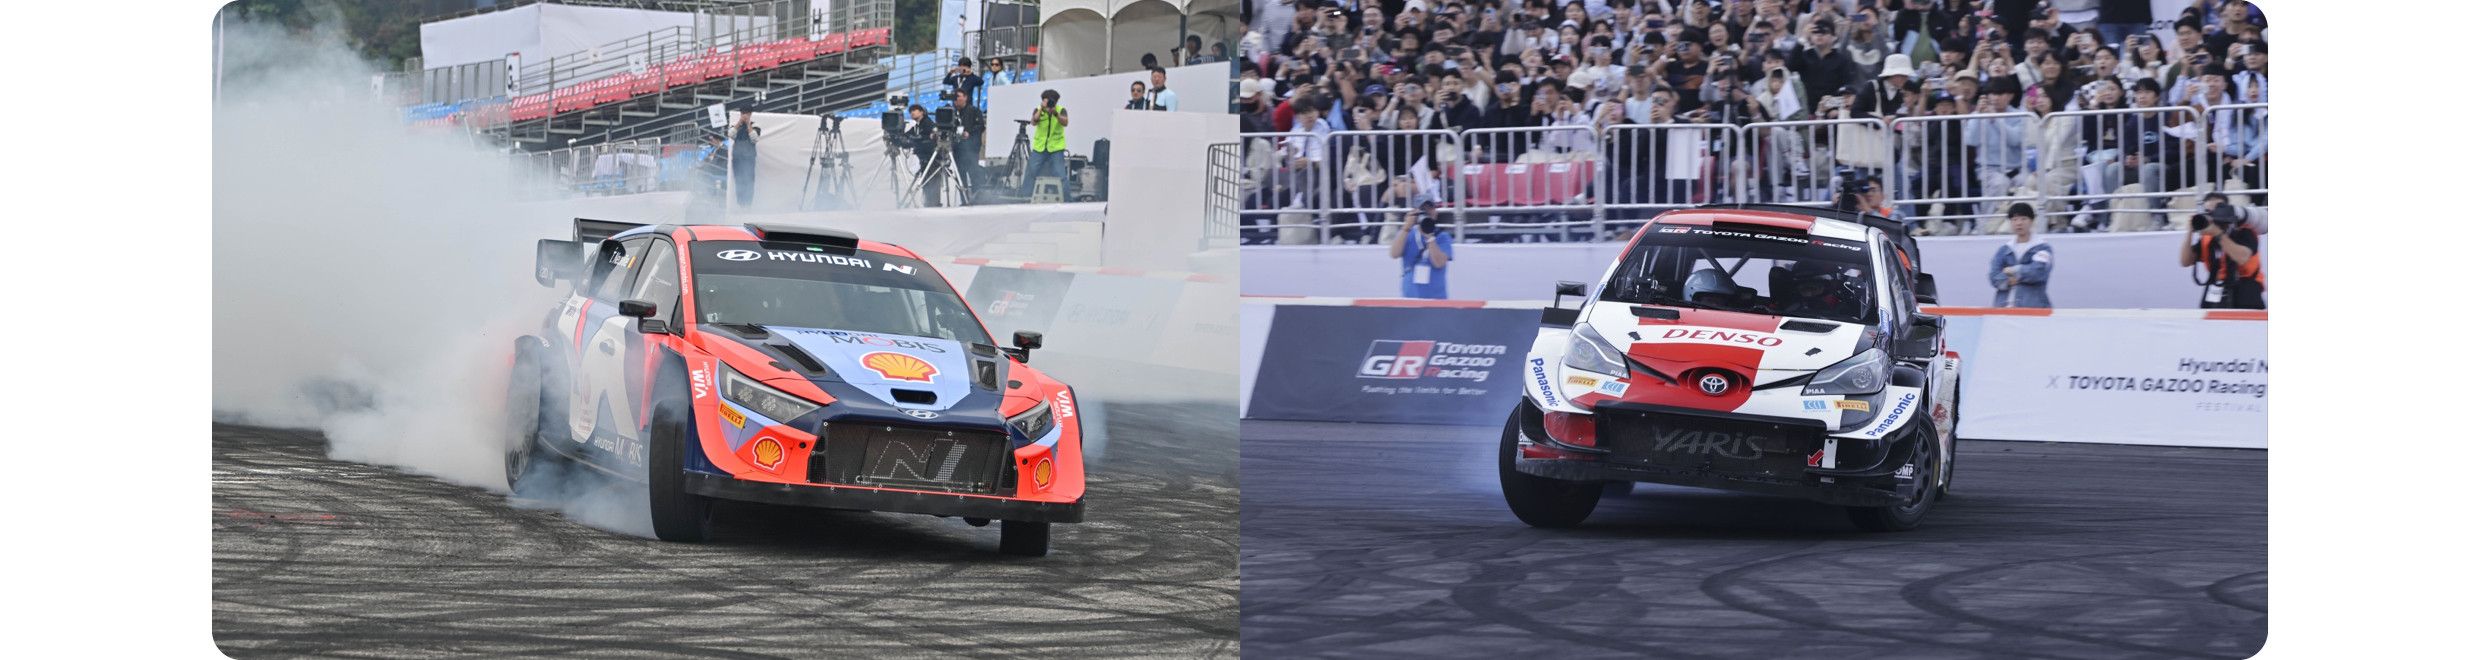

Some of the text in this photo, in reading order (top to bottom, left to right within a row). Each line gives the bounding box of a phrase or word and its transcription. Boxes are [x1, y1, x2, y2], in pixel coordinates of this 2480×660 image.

[1693, 229, 1751, 238] TOYOTA
[1754, 234, 1809, 244] GAZOO
[1811, 240, 1862, 251] Racing
[768, 251, 872, 269] HYUNDAI
[829, 335, 946, 353] MOBIS
[1662, 328, 1783, 347] DENSO
[1435, 342, 1507, 355] TOYOTA
[1361, 355, 1425, 377] GR
[1428, 354, 1497, 367] GAZOO
[2178, 357, 2256, 375] Hyundai
[703, 361, 712, 387] HYUNDAI
[1424, 367, 1490, 382] Racing
[1530, 358, 1560, 408] Panasonic
[1610, 370, 1627, 378] PIAA
[2068, 375, 2136, 391] TOYOTA
[2140, 378, 2204, 393] GAZOO
[2206, 380, 2268, 399] Racing
[720, 403, 743, 425] PIRELLI
[1865, 392, 1916, 437] Panasonic
[2197, 402, 2263, 413] FESTIVAL
[594, 436, 643, 463] HYUNDAI MOBIS
